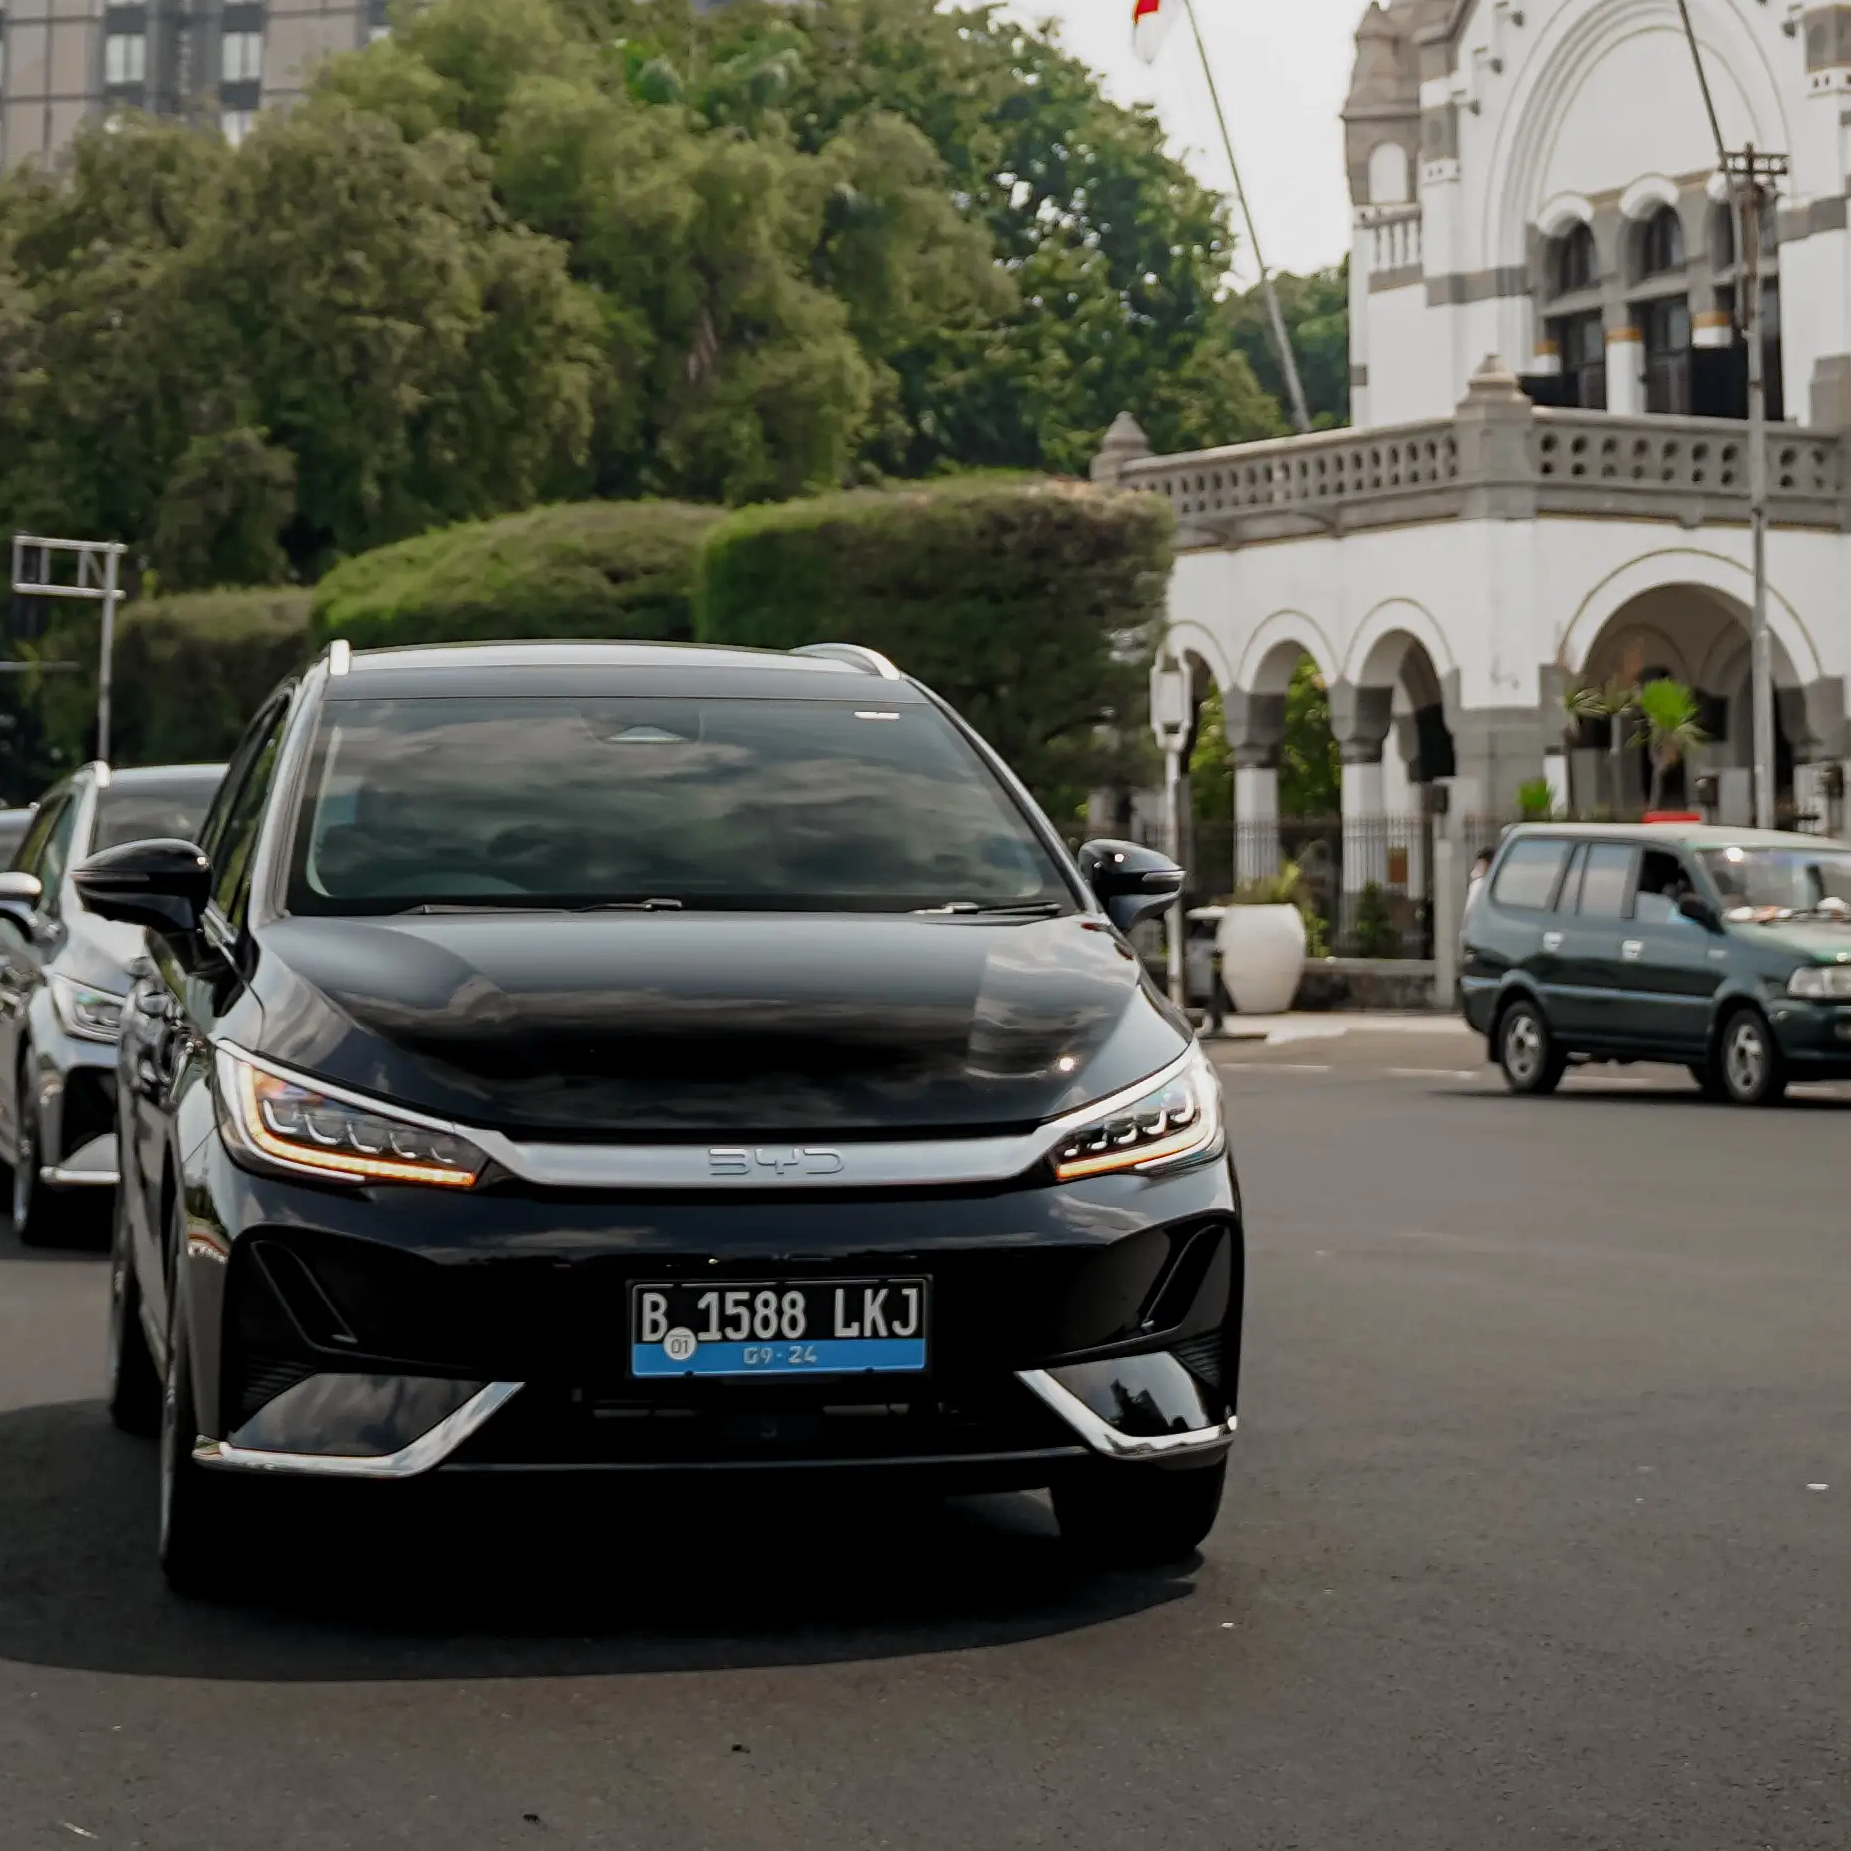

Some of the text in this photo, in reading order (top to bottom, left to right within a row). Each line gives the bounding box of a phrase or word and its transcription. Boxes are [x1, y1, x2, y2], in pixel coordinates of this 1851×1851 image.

[707, 1147, 846, 1176] BYD
[641, 1287, 920, 1342] B 1588 LKJ
